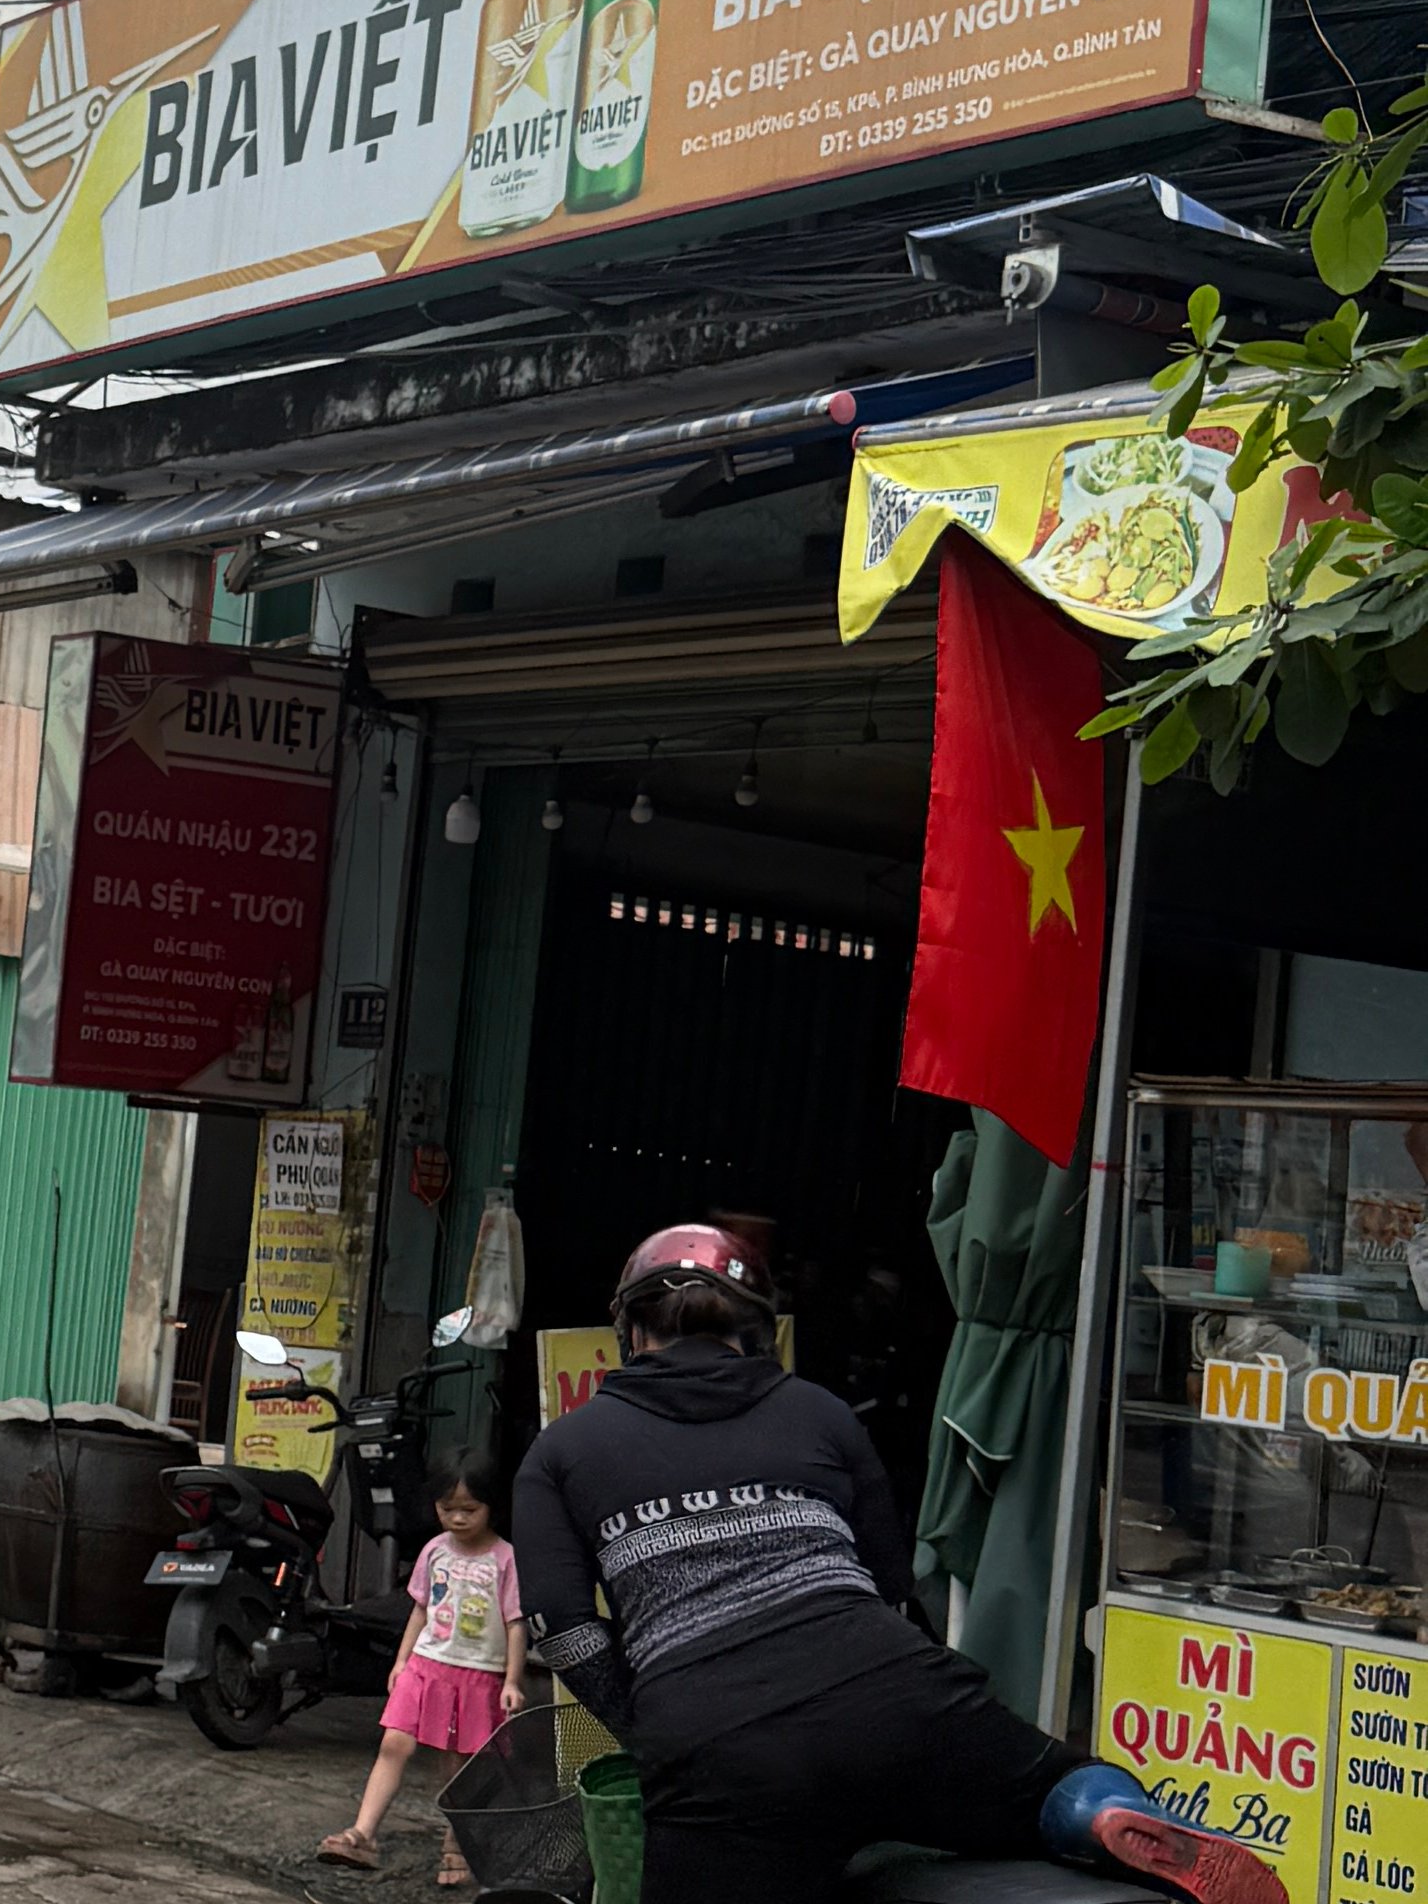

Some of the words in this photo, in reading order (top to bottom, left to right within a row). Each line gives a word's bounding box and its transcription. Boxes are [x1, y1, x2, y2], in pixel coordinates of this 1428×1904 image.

[686, 64, 743, 110] ĐẶC
[748, 44, 813, 93] BIỆT:
[820, 31, 860, 73] GÀ
[867, 11, 947, 60] QUAY
[902, 73, 943, 101] BÌNH
[947, 59, 1001, 90] HƯNG
[1003, 48, 1049, 76] HÒA,
[1122, 17, 1163, 45] TÂN
[139, 55, 259, 210] BIA
[470, 125, 508, 171] BIA
[513, 108, 568, 159] VIỆT
[820, 129, 852, 158] ĐT:
[857, 116, 908, 148] 0339
[912, 104, 949, 136] 255
[954, 96, 993, 127] 350
[185, 689, 242, 738] BIA
[249, 697, 327, 754] VIỆT
[93, 809, 171, 844] QUÁN
[177, 820, 252, 856] NHẬU
[260, 825, 318, 863] 232
[93, 876, 142, 909] BIA
[150, 879, 206, 920] SỆT
[229, 892, 305, 929] TƯƠI
[99, 959, 123, 978] GÀ
[126, 963, 170, 985] QUAY
[171, 969, 235, 992] NGUYÊN
[237, 978, 273, 996] CON
[346, 997, 386, 1025] 112
[1200, 1352, 1289, 1431] MÌ
[1178, 1631, 1256, 1698] MÌ
[1354, 1662, 1410, 1698] SƯỜN
[1111, 1700, 1317, 1790] QUẢNG
[1350, 1709, 1408, 1746] SƯỜN
[1348, 1756, 1404, 1794] SƯỜN
[1216, 1793, 1292, 1845] Ba
[1342, 1850, 1369, 1884] CÁ
[1375, 1857, 1415, 1894] LÓC
